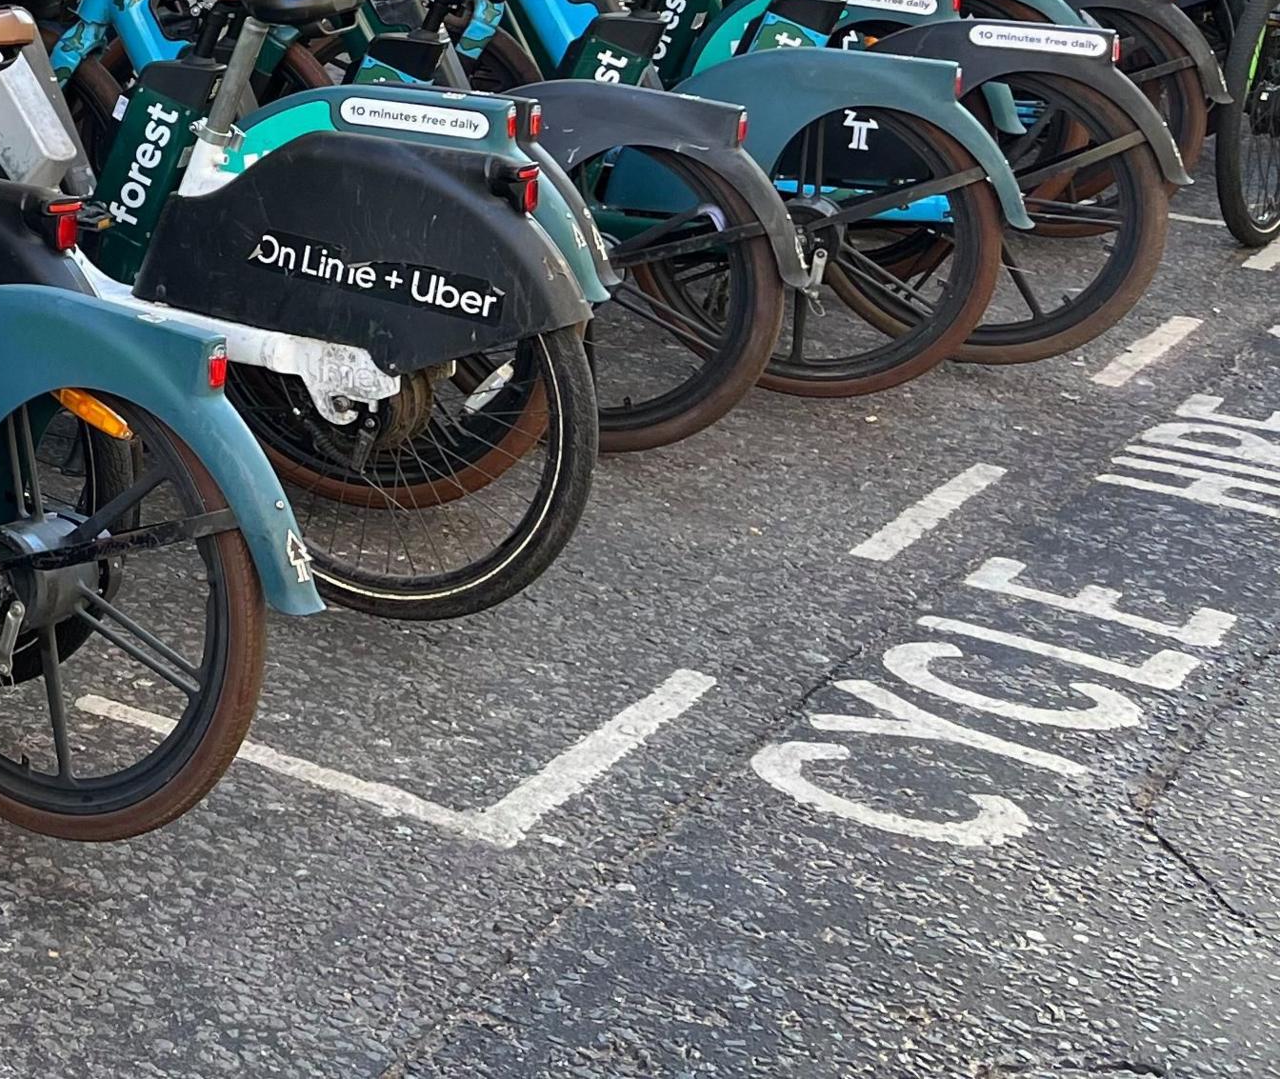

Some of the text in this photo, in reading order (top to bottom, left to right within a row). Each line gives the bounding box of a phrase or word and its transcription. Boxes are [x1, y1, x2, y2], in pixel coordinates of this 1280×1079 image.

[906, 0, 930, 9] daily
[979, 30, 1098, 51] 10 minutes free daily
[350, 105, 479, 132] 10 minutes free daily
[109, 102, 179, 226] forest
[257, 234, 295, 270] On
[385, 270, 403, 289] +
[411, 270, 497, 317] Uber
[751, 557, 1236, 846] CYCLE
